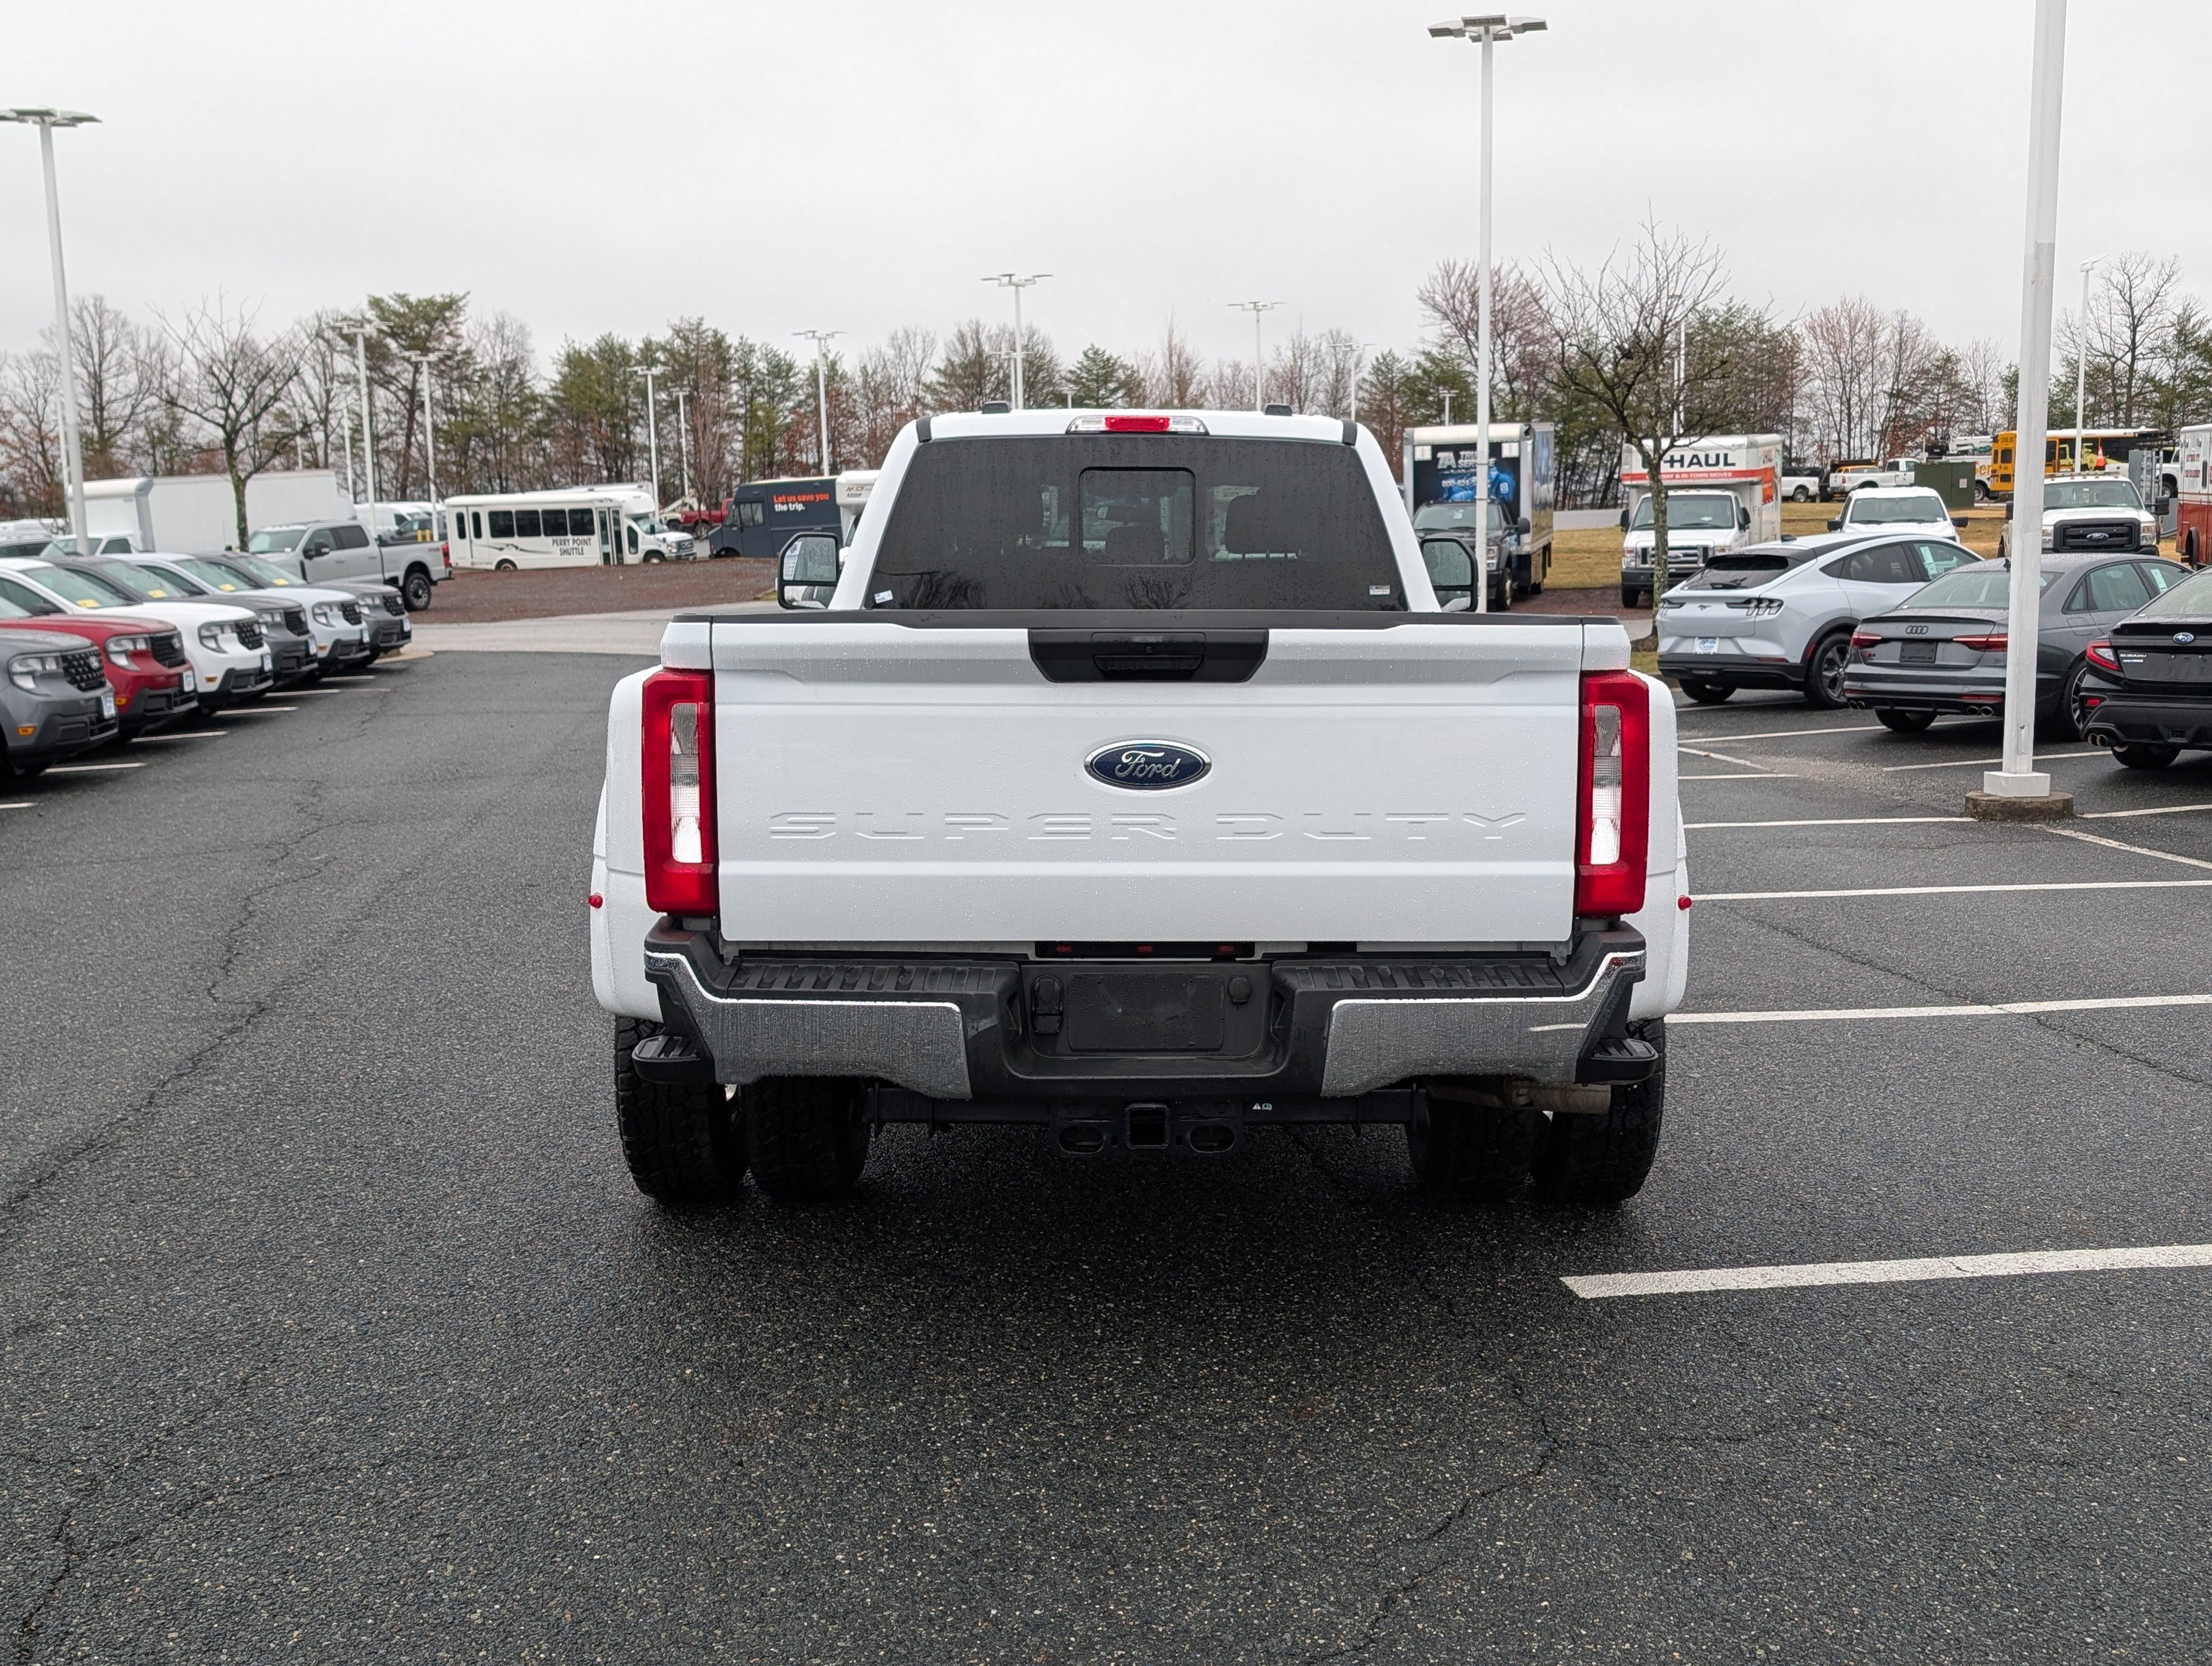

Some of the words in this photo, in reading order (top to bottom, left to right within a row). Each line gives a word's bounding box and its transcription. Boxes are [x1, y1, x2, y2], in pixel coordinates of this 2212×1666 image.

[1437, 451, 1457, 469] TA
[774, 495, 787, 503] Let
[815, 493, 829, 502] you
[774, 503, 788, 512] the
[788, 502, 806, 512] trip.
[552, 537, 570, 547] PERRY
[572, 537, 591, 547] POINT
[560, 547, 584, 556] SHUTTLE
[1115, 750, 1181, 778] Ford
[770, 811, 1176, 840] SUPER
[1216, 812, 1526, 840] DUTY
